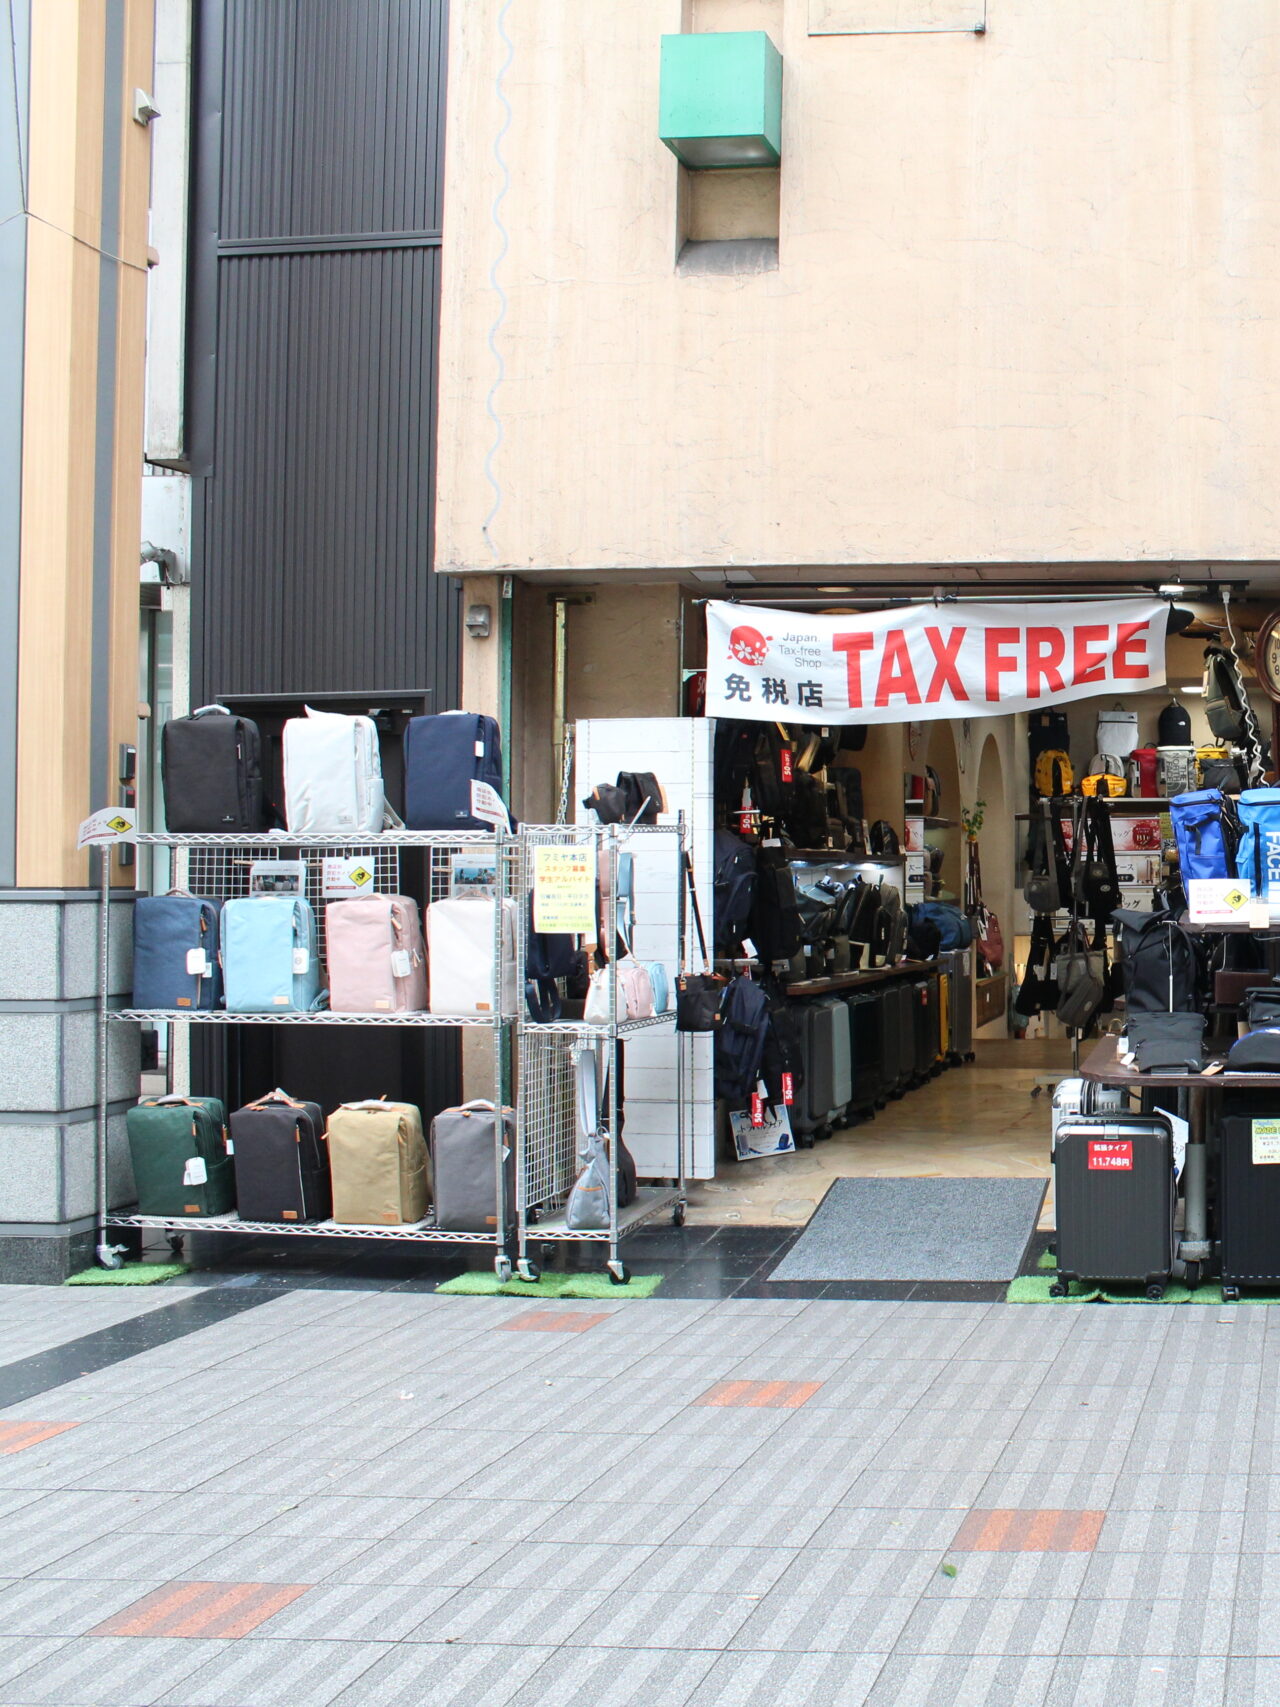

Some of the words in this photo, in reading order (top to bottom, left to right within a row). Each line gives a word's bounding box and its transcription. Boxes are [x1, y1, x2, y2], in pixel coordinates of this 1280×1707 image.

[778, 645, 821, 656] Tax-free
[794, 657, 822, 669] Shop
[832, 626, 970, 709] TAX
[984, 620, 1150, 702] FREE
[724, 672, 823, 709] 免税店
